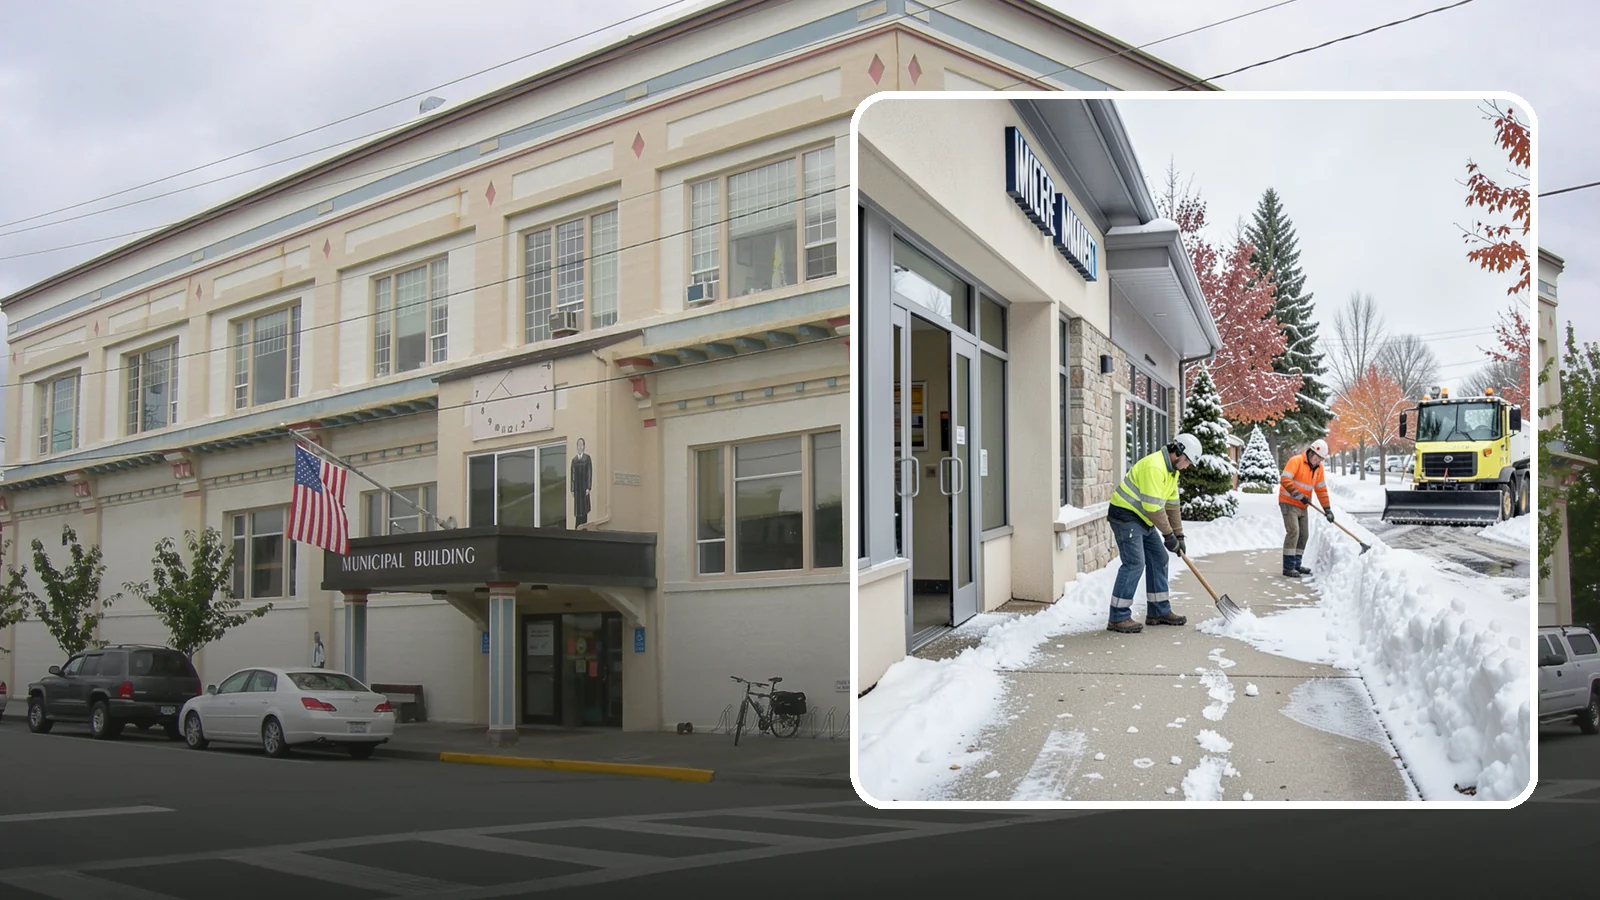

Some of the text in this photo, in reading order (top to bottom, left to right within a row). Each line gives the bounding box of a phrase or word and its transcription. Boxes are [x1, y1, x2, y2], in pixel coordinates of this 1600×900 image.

[536, 402, 540, 410] 4
[528, 413, 533, 422] 3
[494, 423, 500, 431] 10
[507, 425, 513, 433] 12
[520, 420, 525, 428] 2
[342, 546, 475, 572] MUNICIPAL BUILDING
